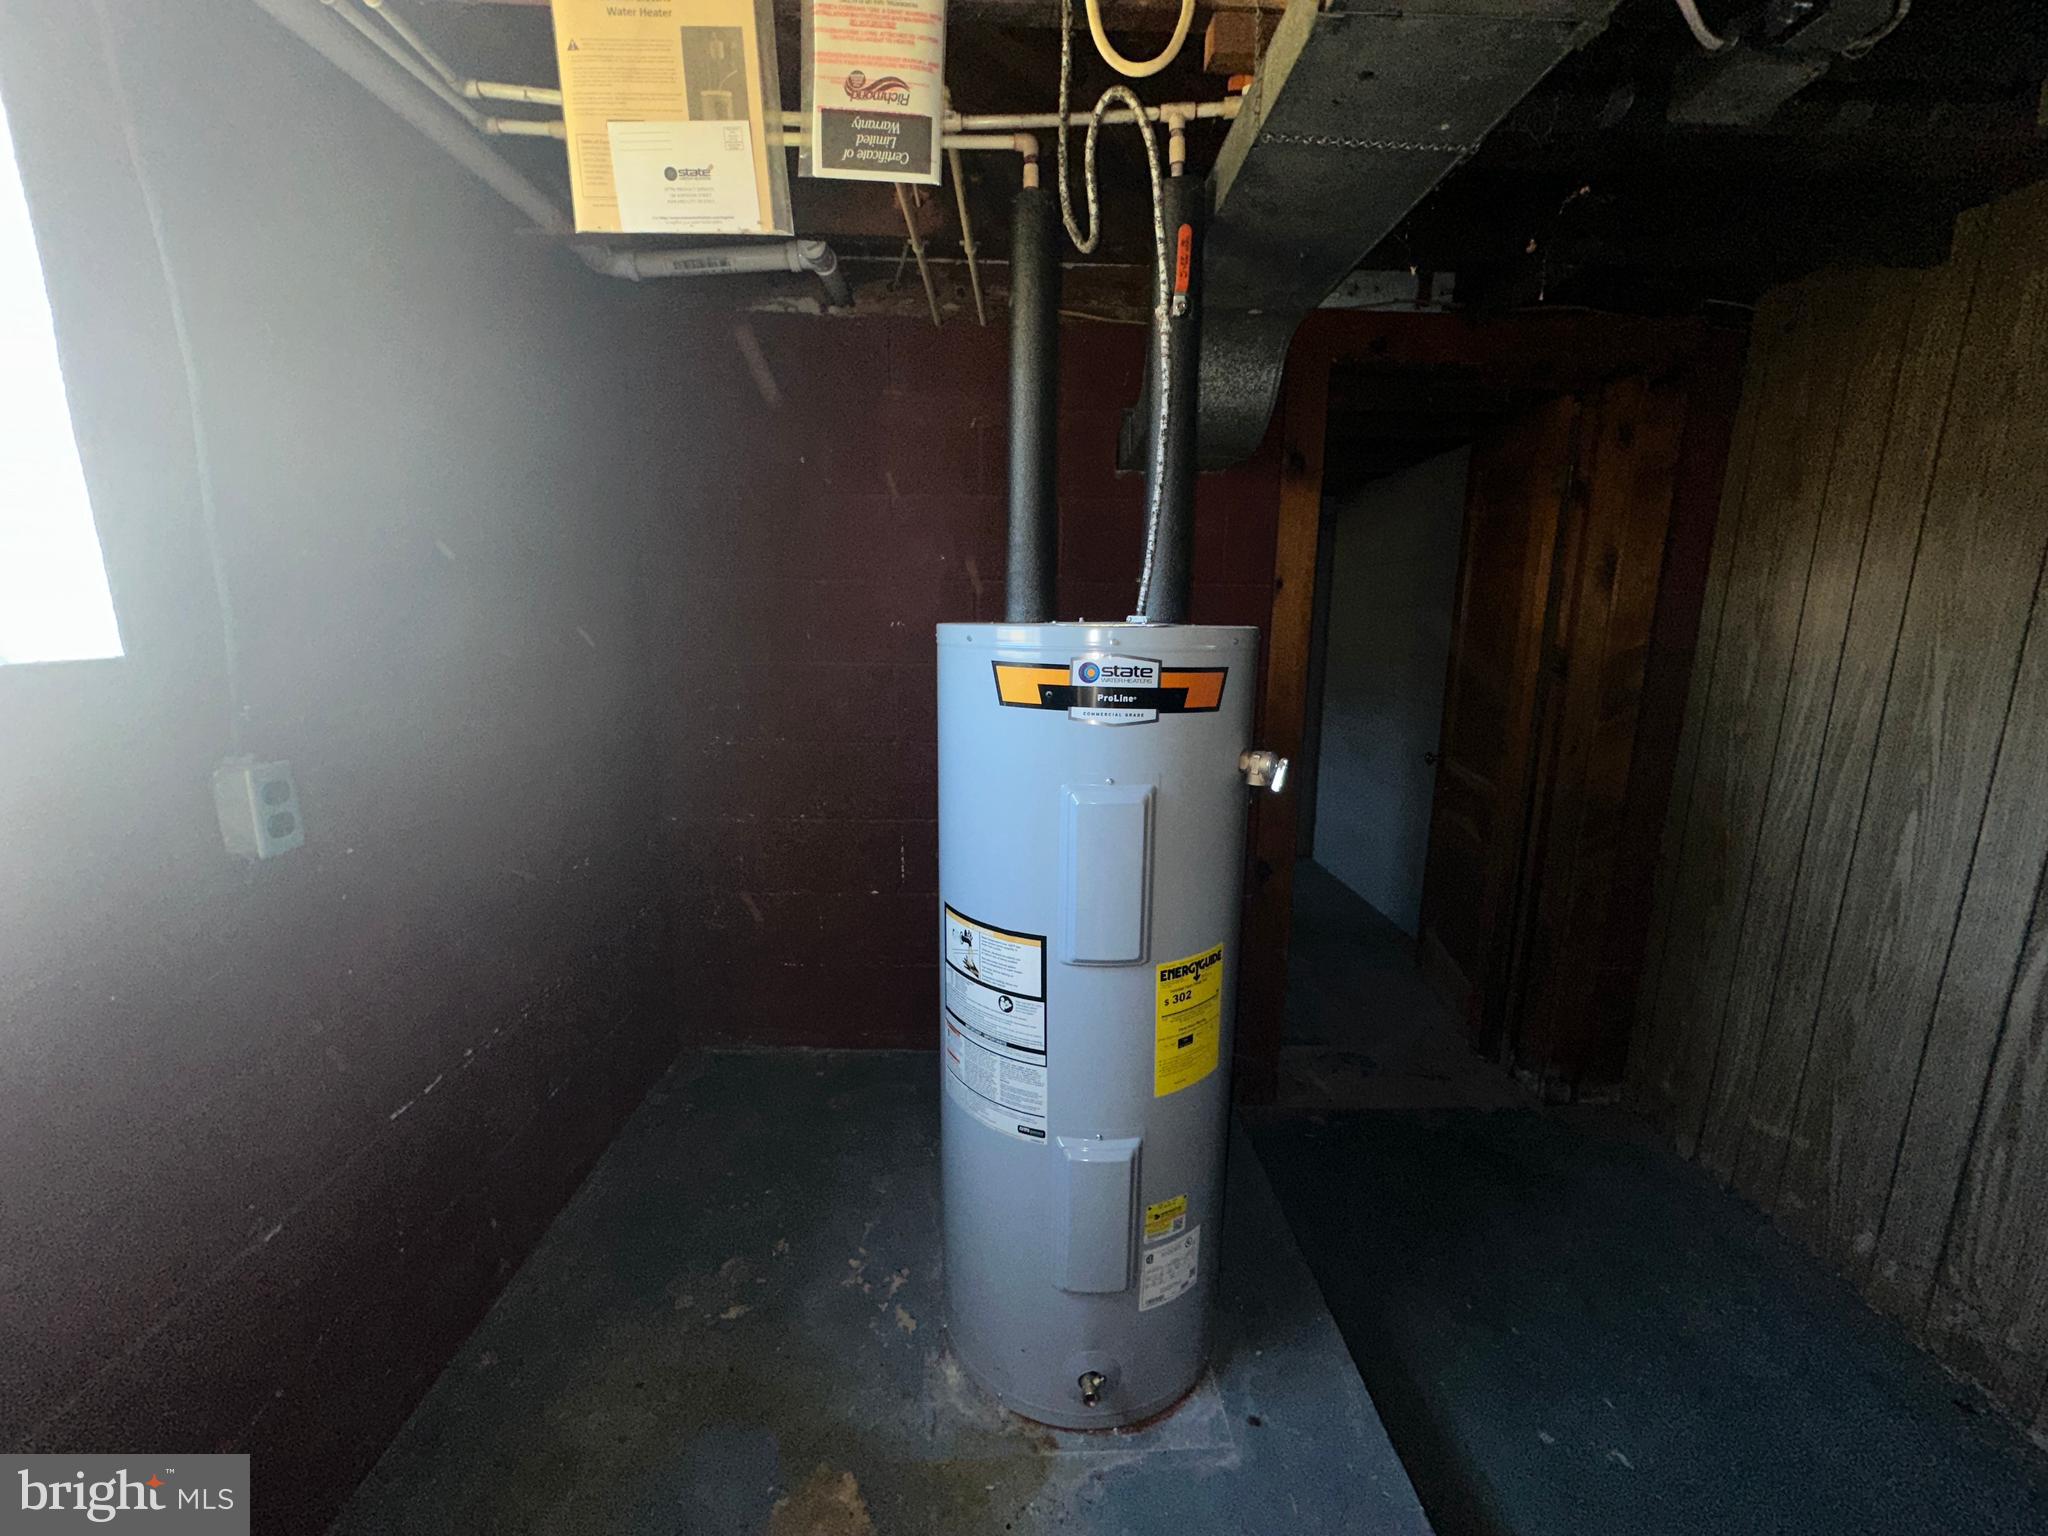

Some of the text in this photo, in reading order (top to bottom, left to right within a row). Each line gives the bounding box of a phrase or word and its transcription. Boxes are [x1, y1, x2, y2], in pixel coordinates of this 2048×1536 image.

[607, 7, 672, 17] Water Heater
[850, 90, 910, 106] Richmond
[851, 116, 900, 134] Warranty
[856, 134, 897, 149] Limited
[842, 148, 909, 165] Certificate of
[679, 168, 711, 177] state
[1101, 665, 1153, 678] state
[1160, 949, 1222, 982] ENERGYGUIDE
[1172, 990, 1192, 1004] 302
